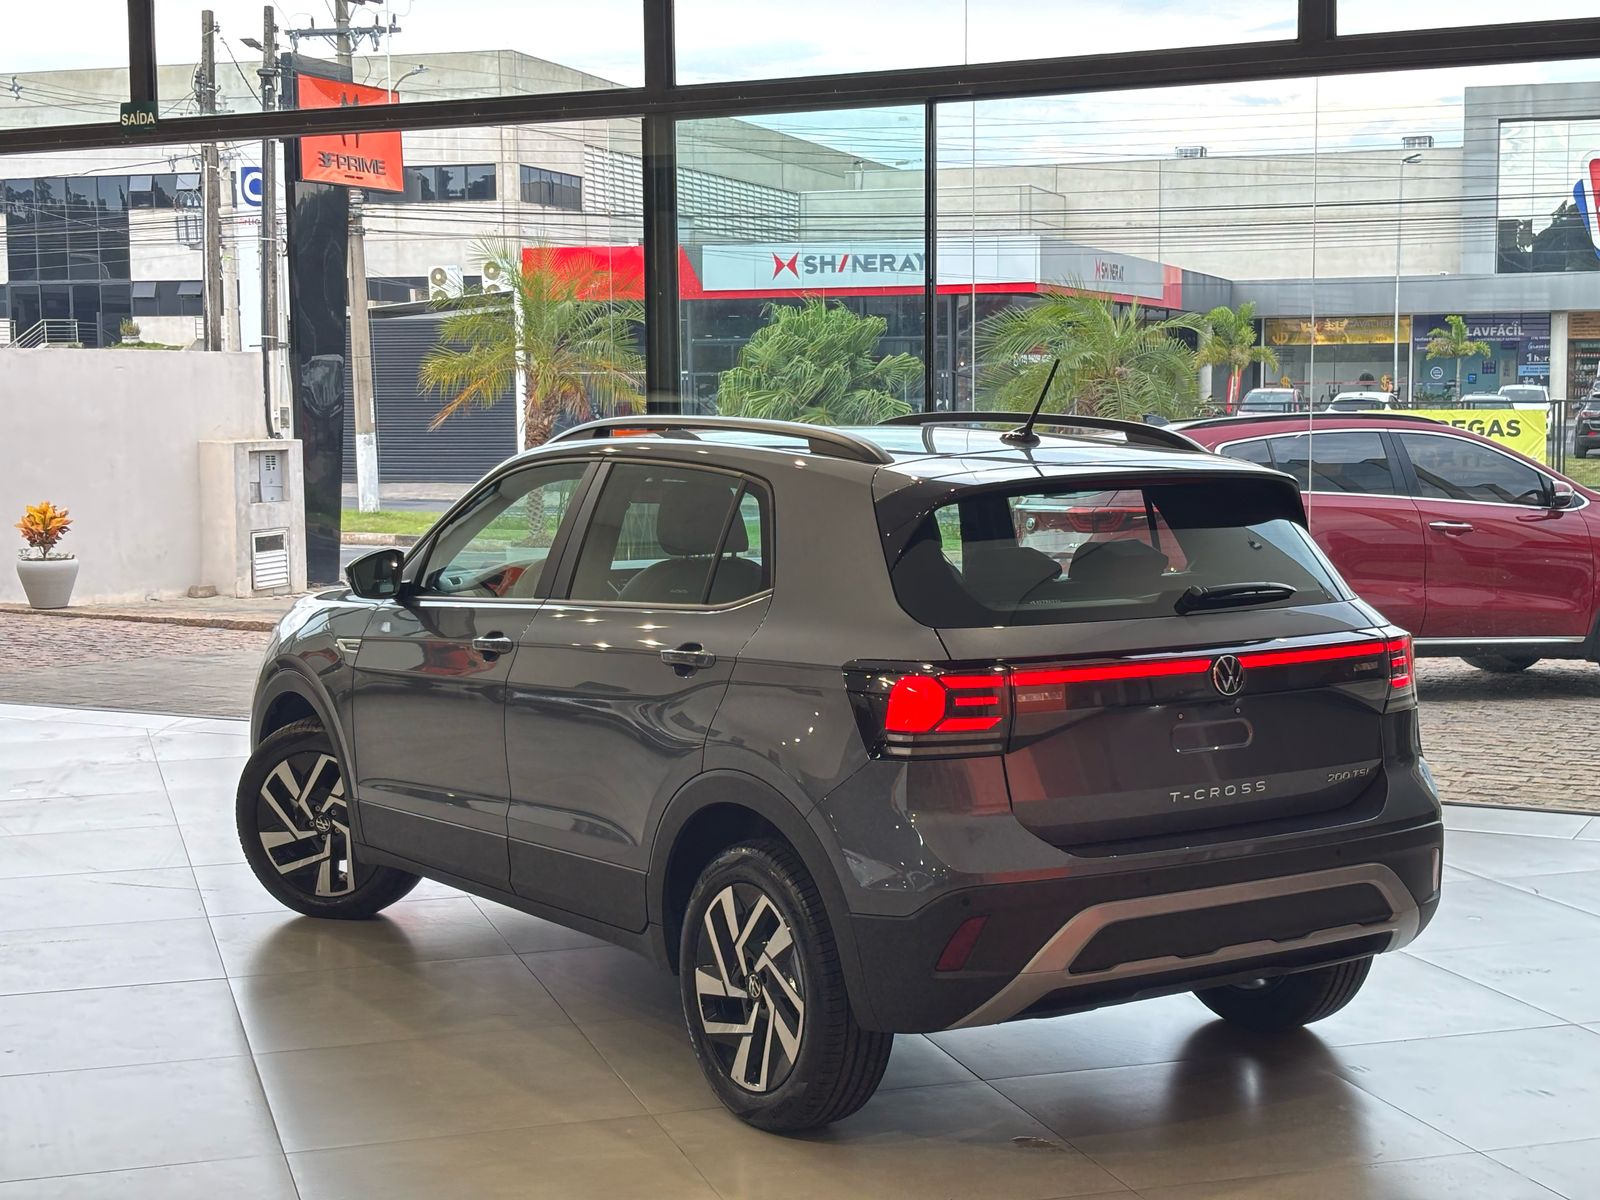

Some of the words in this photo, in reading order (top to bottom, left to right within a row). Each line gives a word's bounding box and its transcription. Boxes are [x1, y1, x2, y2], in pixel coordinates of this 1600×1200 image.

[121, 110, 156, 126] SAÍDA
[336, 154, 386, 176] PRIME
[803, 253, 925, 275] SHINERAY
[1466, 324, 1525, 336] LAVFÁCIL
[1440, 419, 1521, 438] EGAS
[1327, 771, 1351, 782] 200
[1169, 780, 1267, 803] T-CROSS
